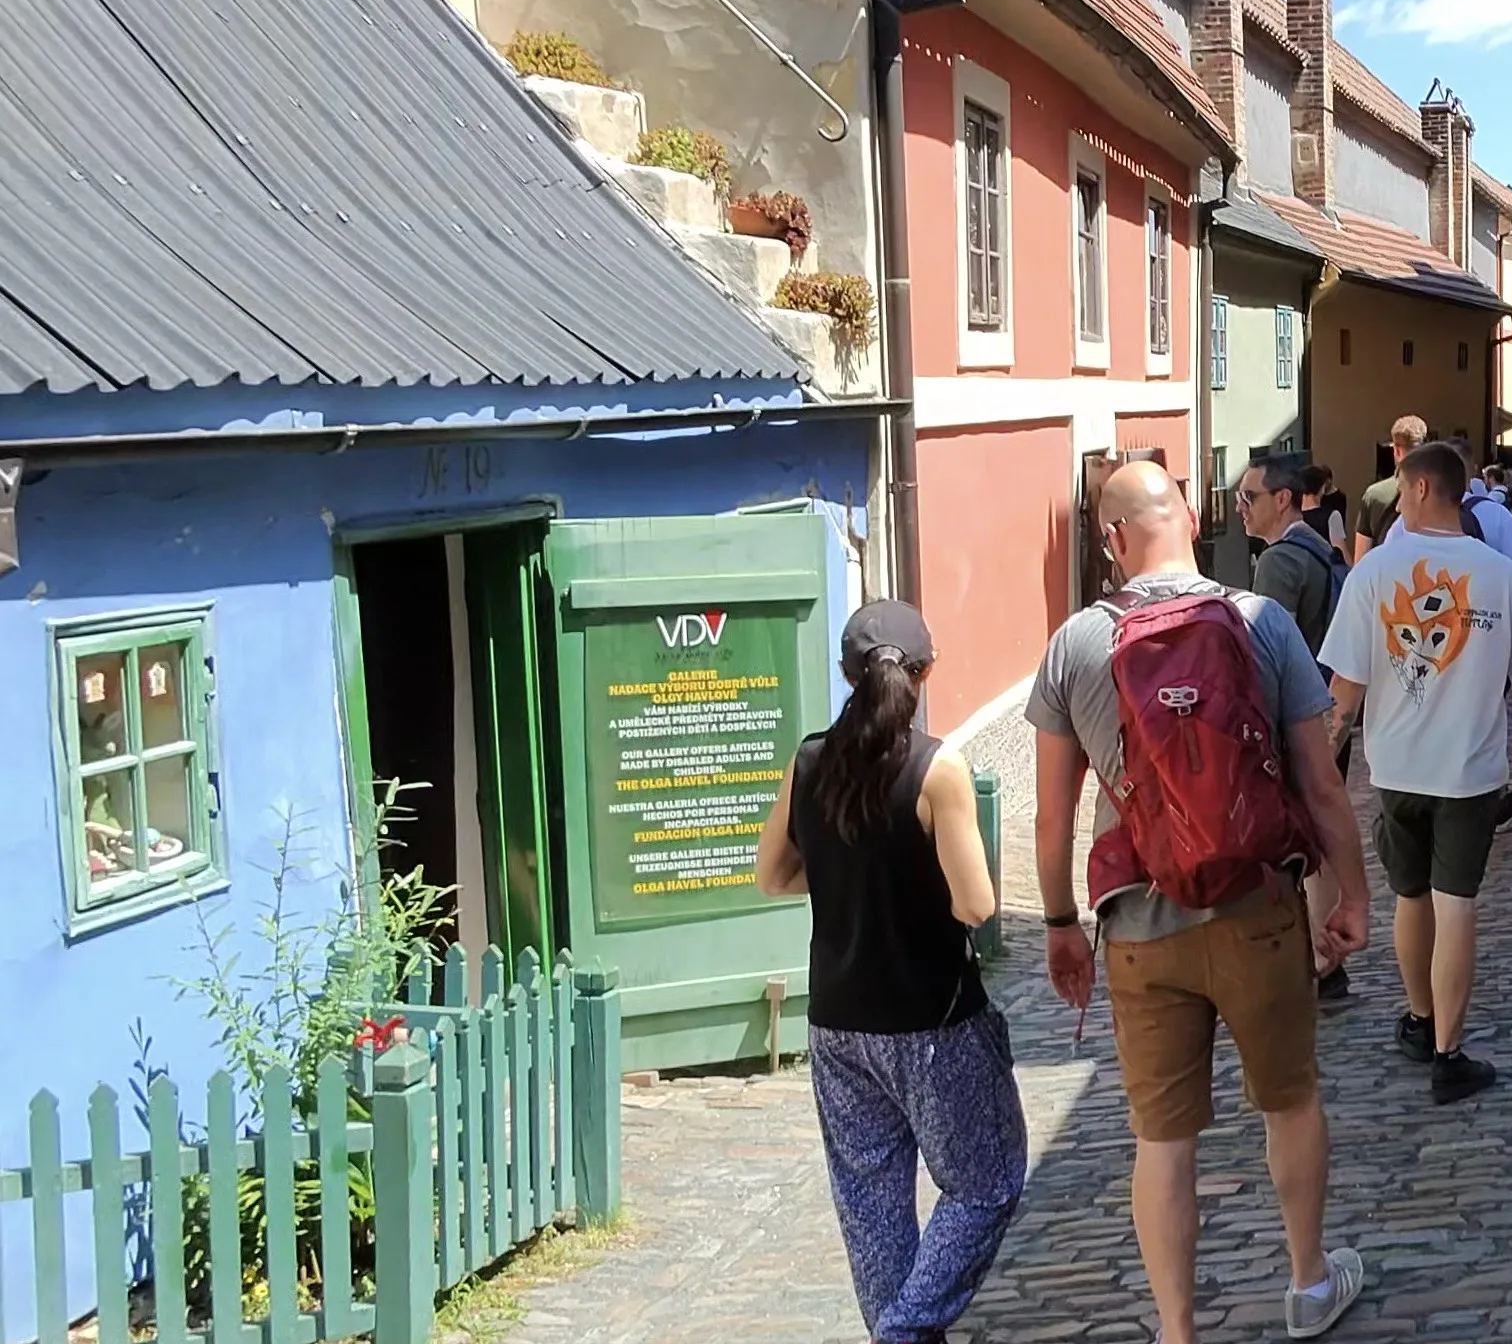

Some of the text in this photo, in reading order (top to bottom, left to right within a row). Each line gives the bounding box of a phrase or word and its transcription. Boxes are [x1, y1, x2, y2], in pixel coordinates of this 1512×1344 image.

[465, 445, 491, 495] 19
[656, 612, 728, 648] VDV
[668, 670, 718, 682] GALERIE
[608, 683, 656, 696] NADACE
[657, 680, 706, 693] VÝBORU
[708, 677, 747, 690] DOBRÉ
[652, 689, 738, 704] OLGY HAVLOVÉ
[644, 700, 749, 716] VÁM NABÍZÍ VÝROBKY
[609, 719, 617, 729] A
[618, 715, 671, 728] UMĚLECKÉ
[619, 719, 777, 739] POSTIŽENÝCH DĚTÍ A DOSPĚLÝCH
[621, 741, 775, 760] OUR GALLERY OFFERS ARTICLES
[620, 751, 774, 770] MADE BY DISABLED ADULTS AND
[673, 765, 726, 777] CHILDREN.
[616, 770, 784, 792] THE OLGA HAVEL FOUNDATION
[609, 791, 780, 814] NUESTRA GALERIA OFRECE ARTÍCUL
[643, 804, 760, 821] HECHOS POR PERSONAS
[664, 815, 742, 830] INCAPACITADAS.
[702, 824, 734, 837] OLGA
[735, 822, 765, 835] HAVE
[629, 851, 669, 864] UNSERE
[671, 848, 712, 860] GALERIE
[713, 845, 745, 857] BIETET
[635, 854, 758, 874] ERZEUGNISSE BEHINDERT
[678, 867, 732, 880] MENSCHEN
[633, 873, 757, 894] OLGA HAVEL FOUNDAT
